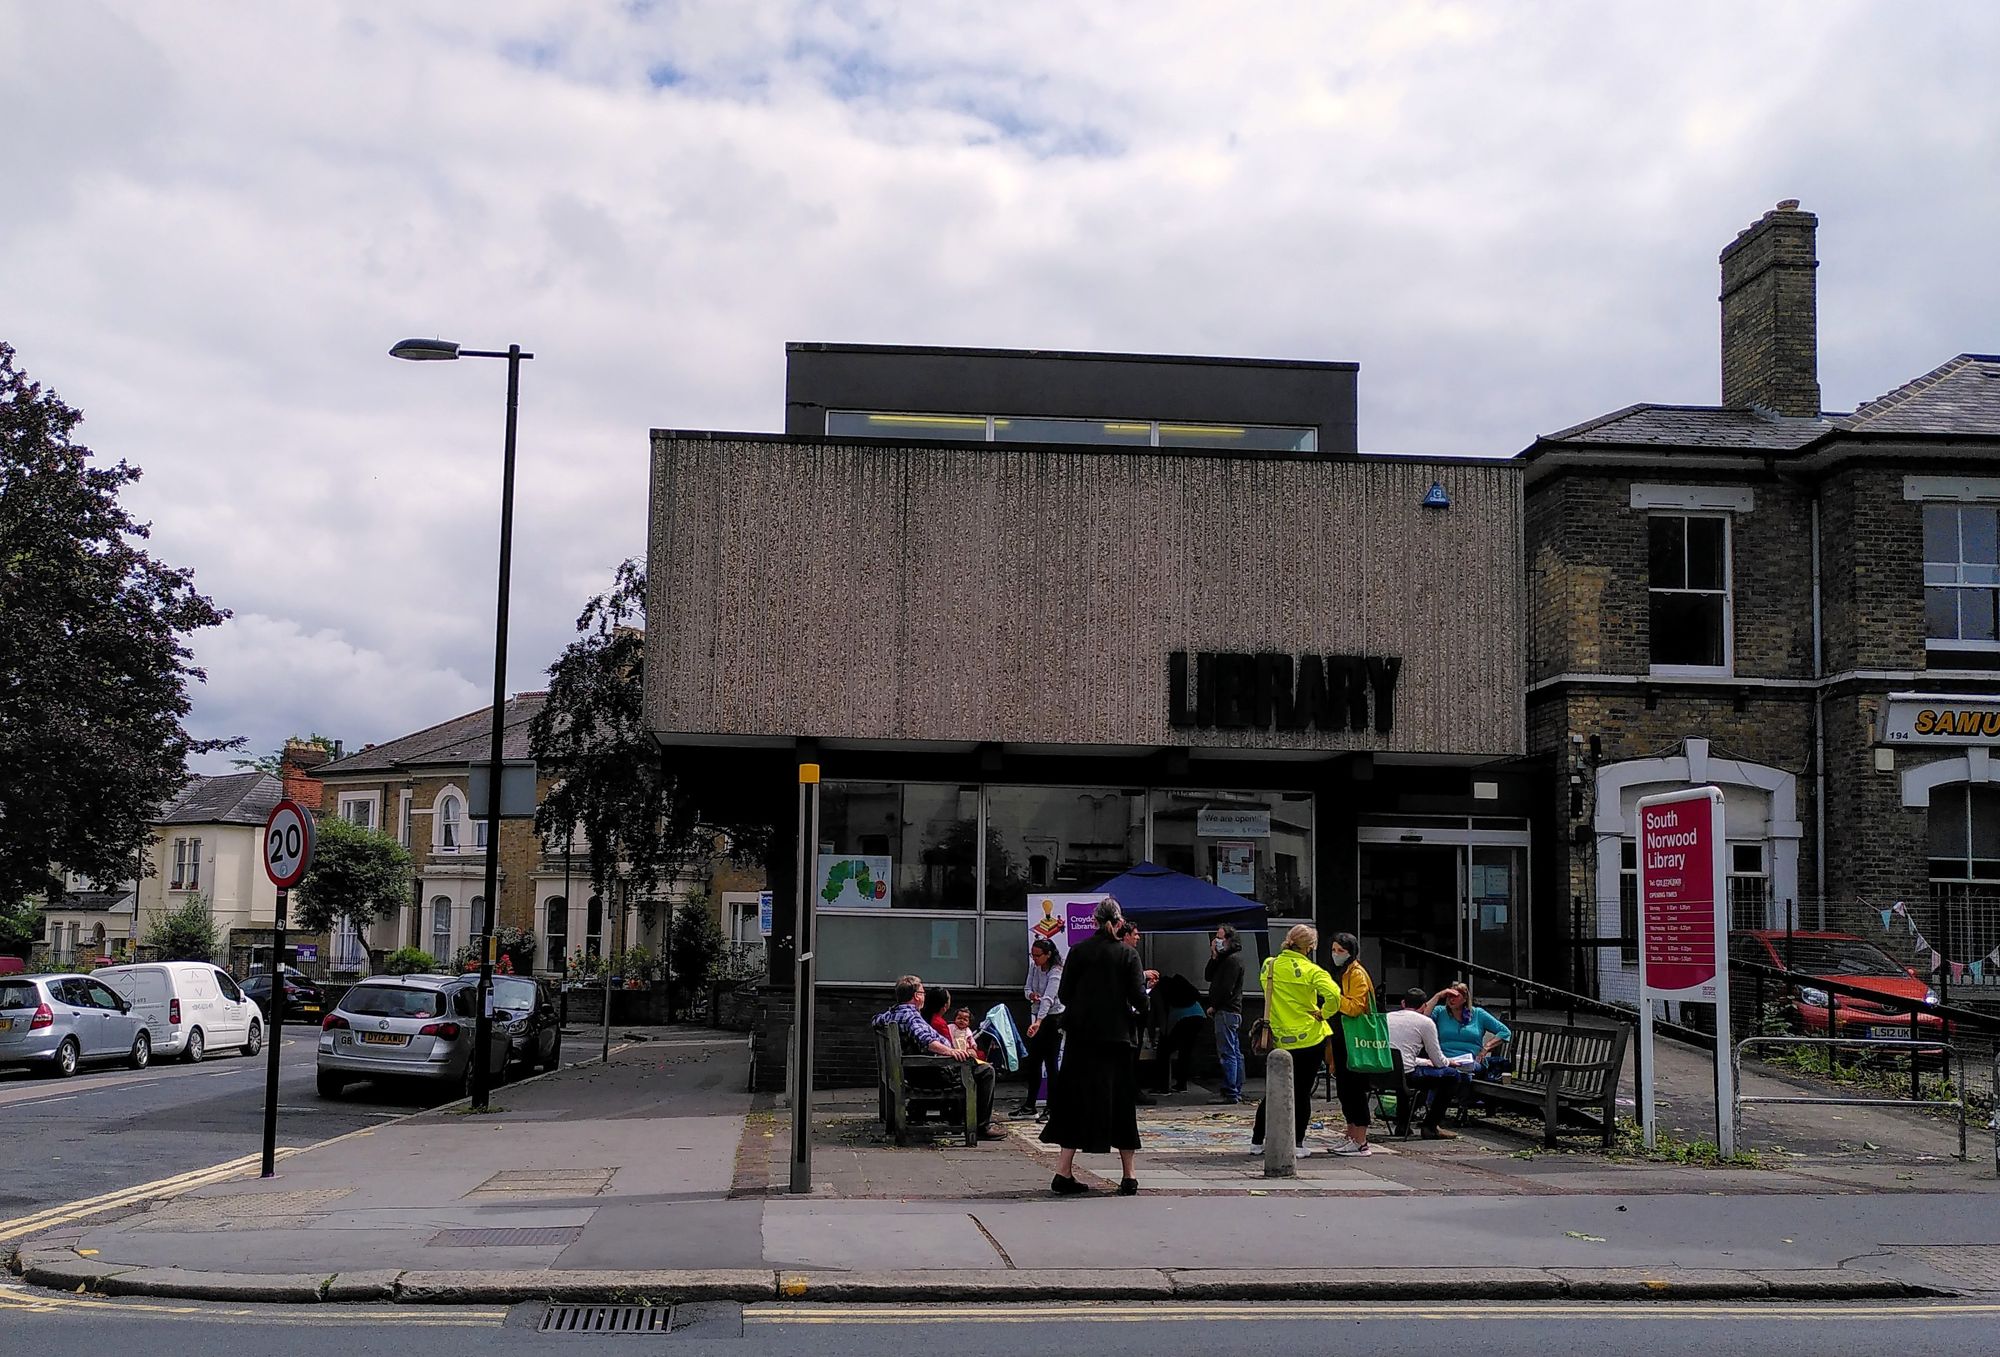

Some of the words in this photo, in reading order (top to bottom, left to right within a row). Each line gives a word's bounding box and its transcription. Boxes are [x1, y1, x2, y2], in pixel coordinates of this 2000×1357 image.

[1169, 651, 1402, 732] LIBRARY
[1889, 731, 1909, 740] 194
[1205, 814, 1218, 822] We
[1646, 810, 1678, 830] South
[270, 823, 301, 864] 20
[1647, 827, 1697, 849] Norwood
[1647, 852, 1686, 871] Library
[368, 1033, 385, 1041] DY12
[1874, 1028, 1895, 1037] LS12
[1897, 1029, 1910, 1038] UK
[341, 1036, 353, 1045] GB
